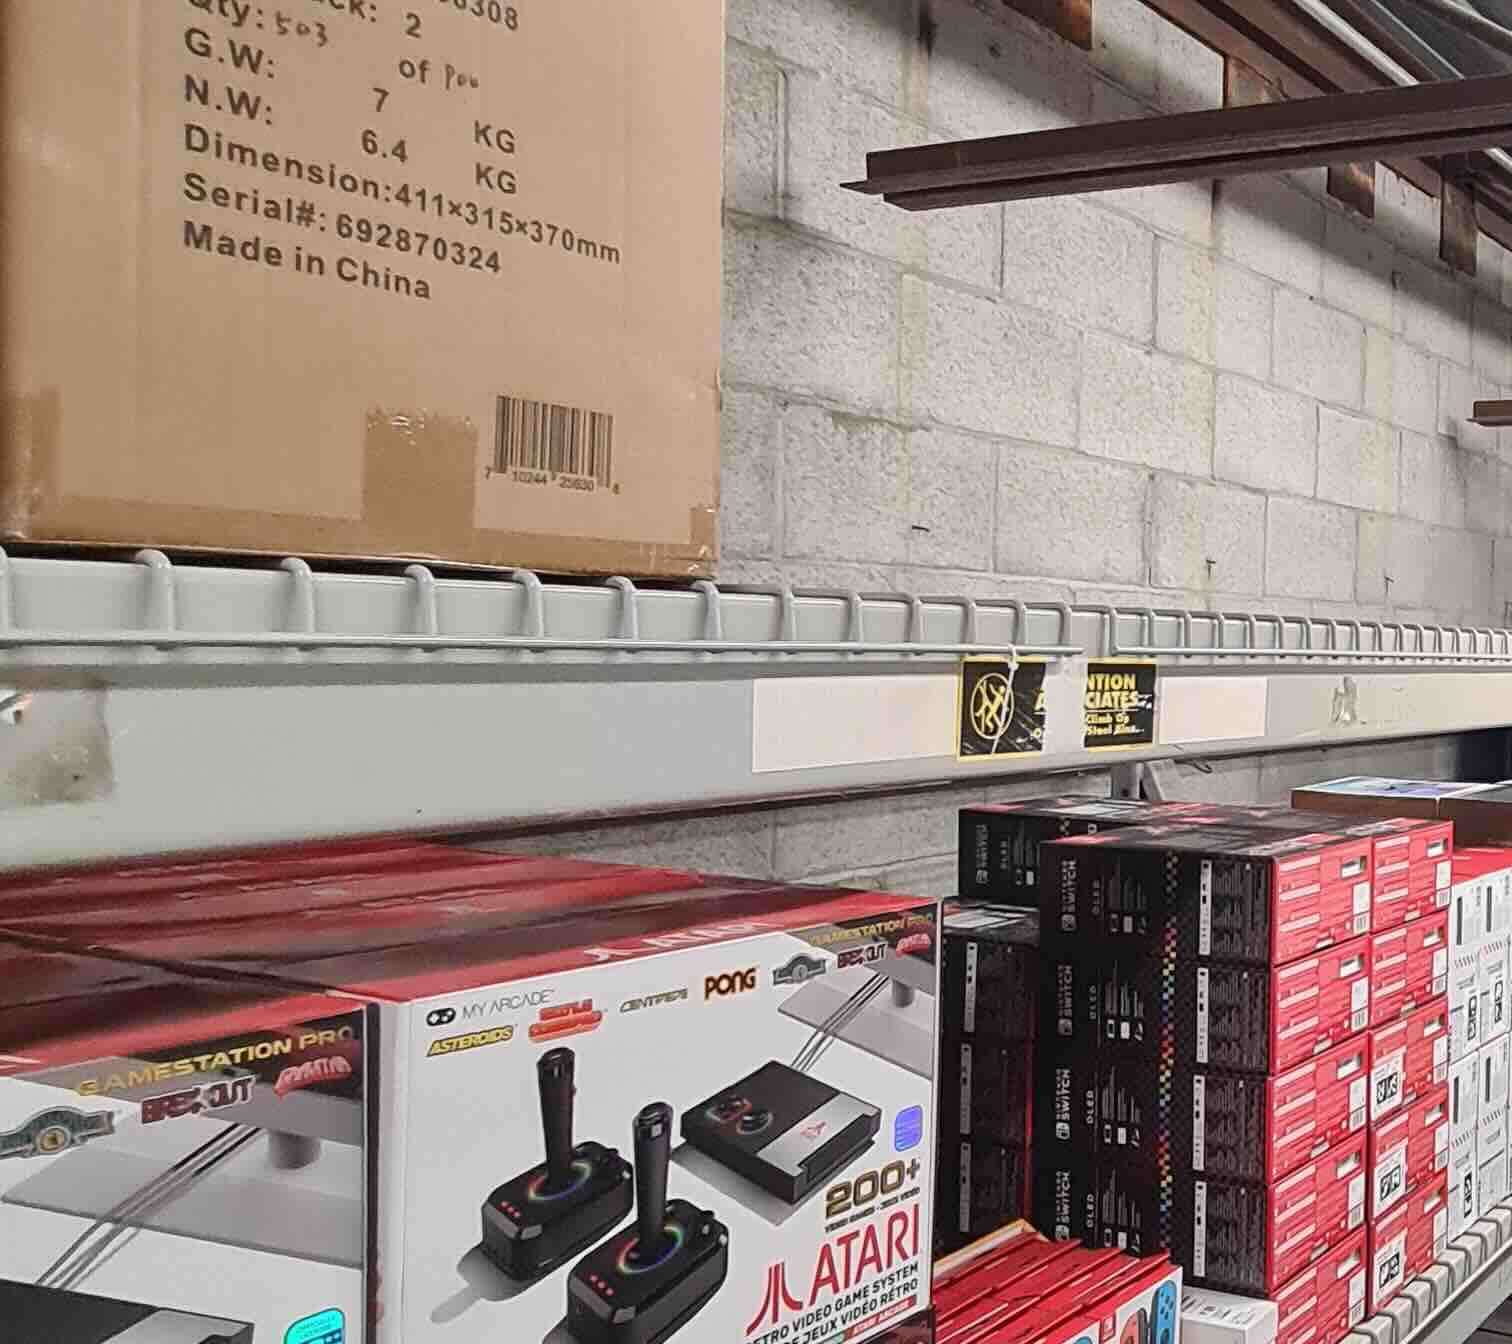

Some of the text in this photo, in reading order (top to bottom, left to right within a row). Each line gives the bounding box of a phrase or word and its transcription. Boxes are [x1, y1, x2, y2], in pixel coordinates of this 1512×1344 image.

[406, 13, 421, 38] 2
[184, 28, 515, 154] G.W: 7 KG
[399, 59, 431, 84] of
[184, 75, 516, 194] N.W: 6.4 KG
[184, 173, 500, 273] Serial#: 692870324
[183, 221, 430, 299] Made in China
[463, 990, 550, 1021] MY ARCADE
[705, 968, 756, 999] PONG
[78, 1038, 291, 1096] GAMESTATION
[299, 1025, 353, 1050] PRO
[427, 1025, 514, 1056] ASTEROIDS
[826, 1158, 920, 1219] 200+
[809, 1204, 919, 1306] ATARI
[793, 1304, 832, 1332] VIDEO
[835, 1288, 869, 1312] GAME
[872, 1263, 918, 1293] SYSTEM
[802, 1315, 838, 1344] JEUX
